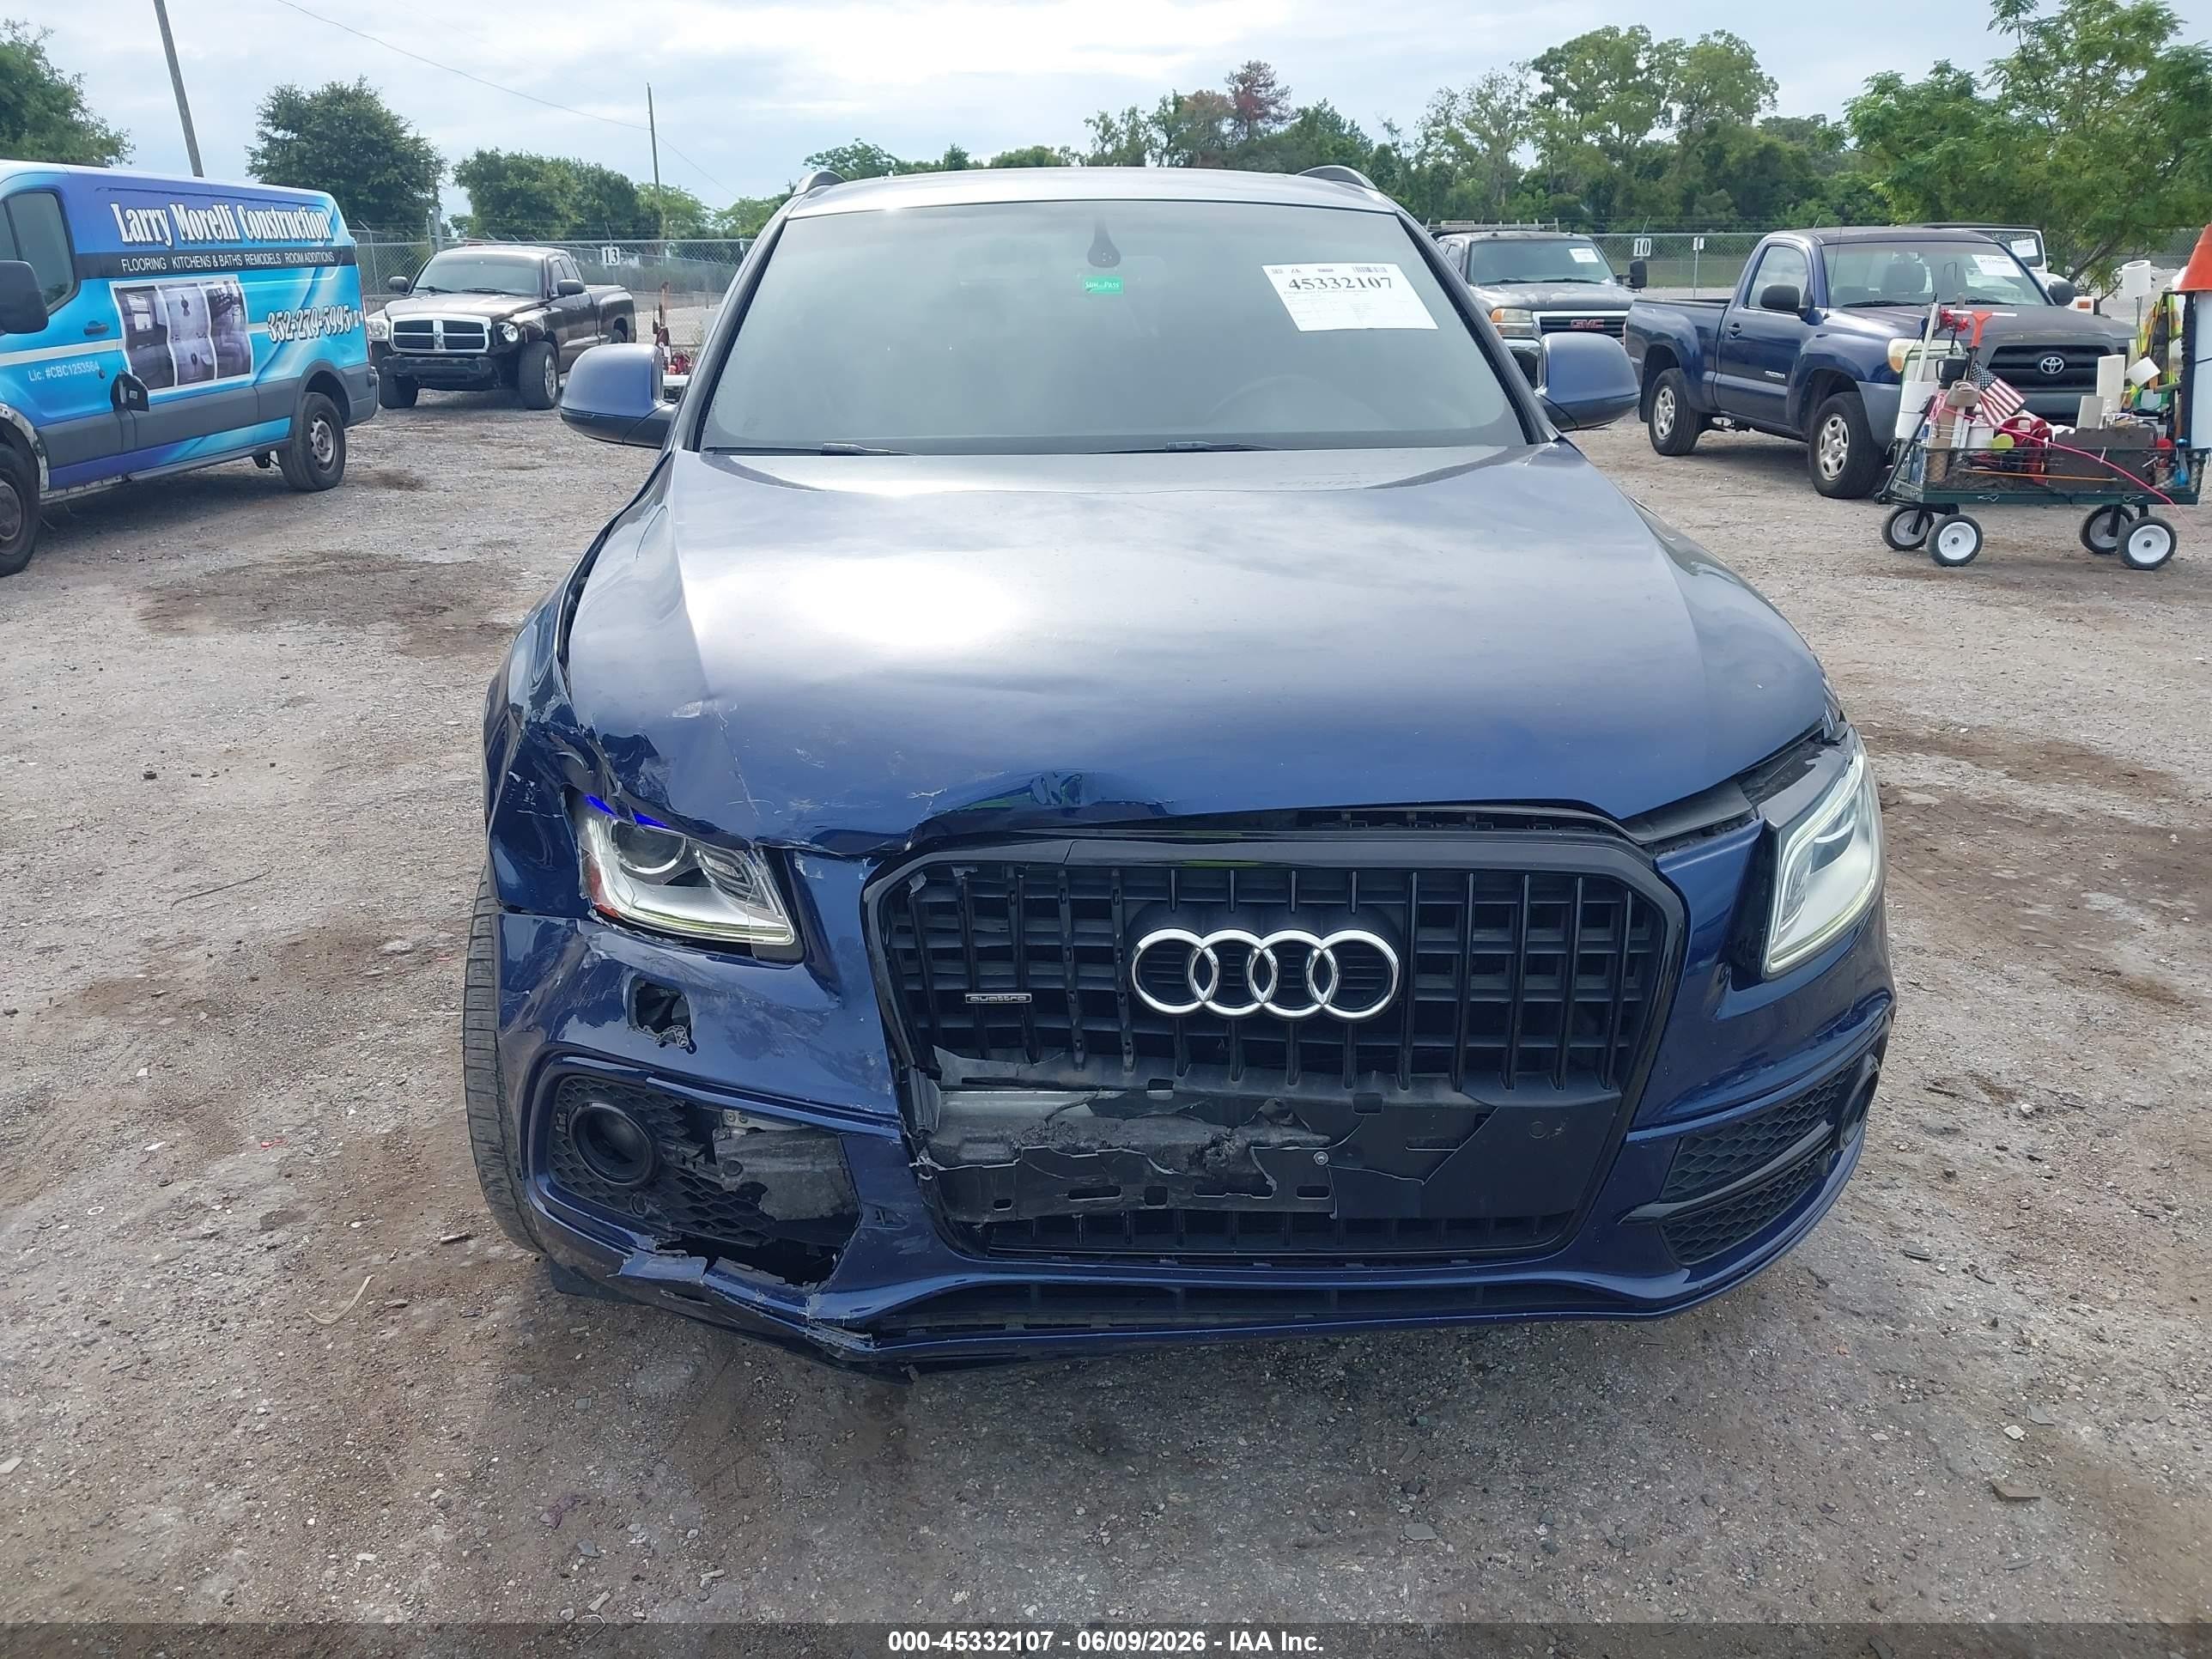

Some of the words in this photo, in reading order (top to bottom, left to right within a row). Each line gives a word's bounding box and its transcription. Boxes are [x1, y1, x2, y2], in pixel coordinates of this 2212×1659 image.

[110, 203, 173, 247] Larry
[169, 204, 241, 241] Morelli
[237, 204, 333, 242] Construction
[1636, 239, 1650, 252] 10
[121, 257, 167, 272] FLOORING
[172, 255, 211, 270] KITCHENS
[212, 255, 218, 267] &
[220, 253, 242, 267] BATHS
[245, 252, 282, 265] REMODELS
[285, 252, 304, 264] ROOM
[304, 252, 335, 263] ADDITIONS
[605, 248, 618, 264] 13
[1288, 277, 1392, 290] 45332107
[267, 305, 351, 343] 352-279-5995
[1571, 319, 1605, 330] GMC
[27, 368, 45, 382] Lic.
